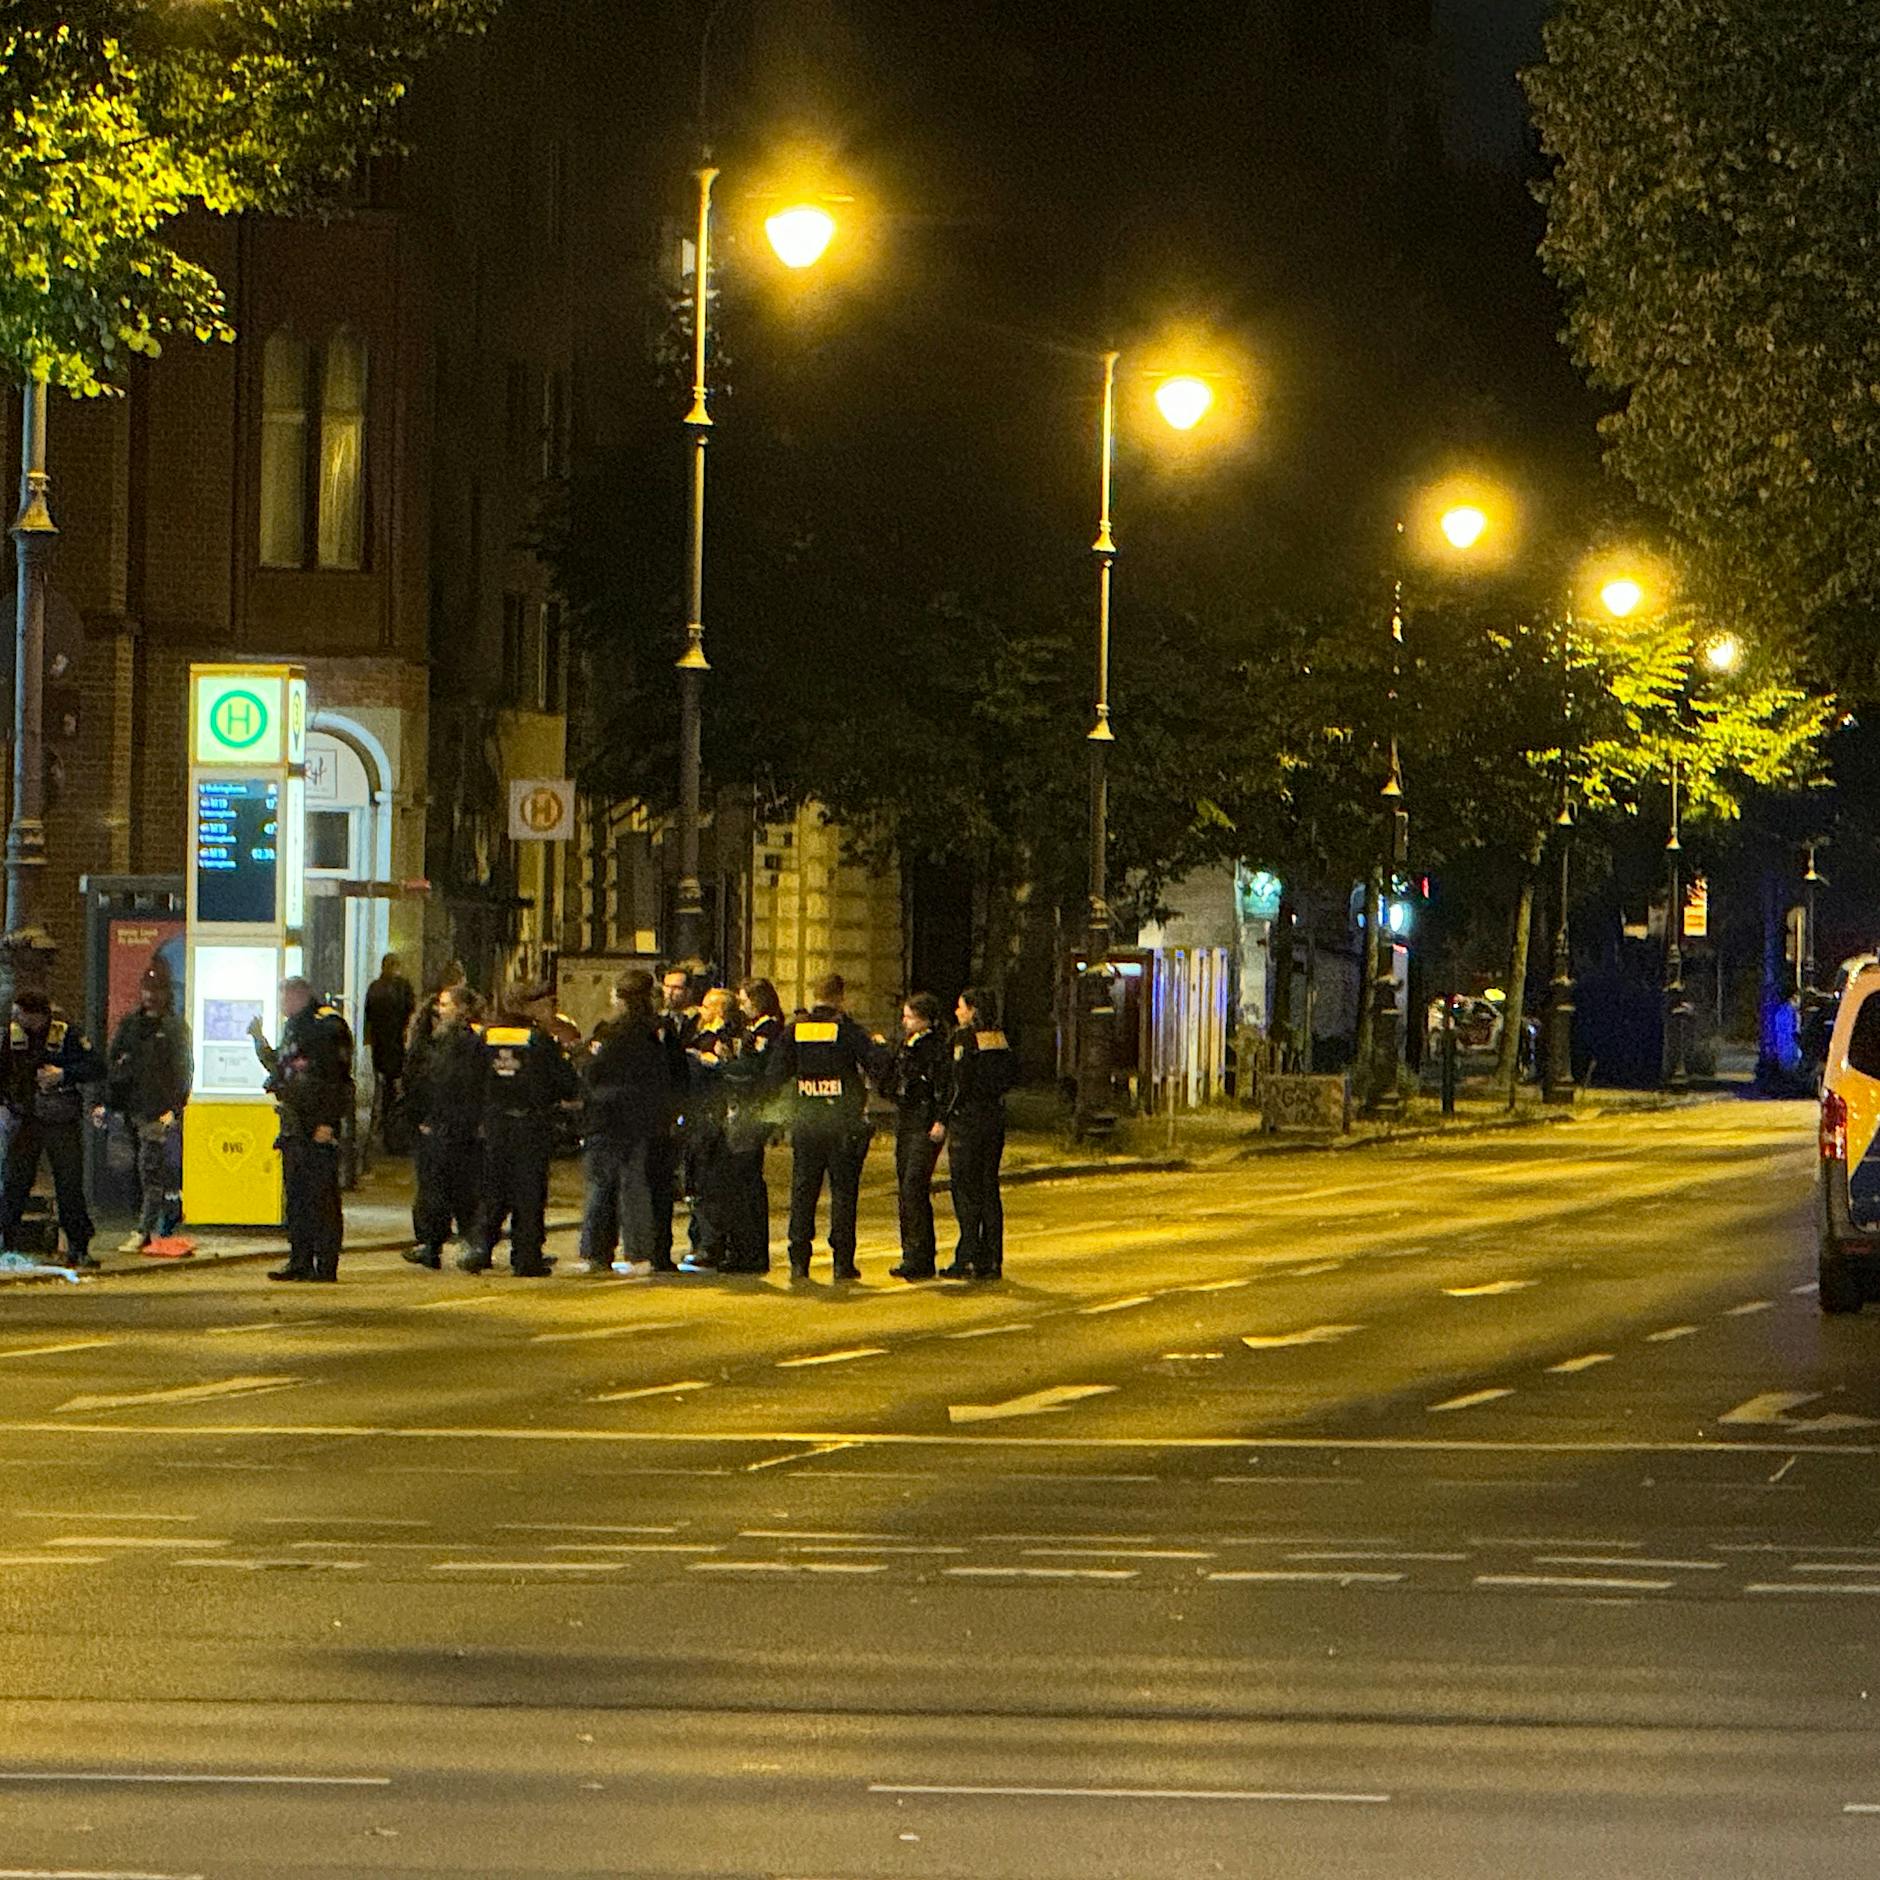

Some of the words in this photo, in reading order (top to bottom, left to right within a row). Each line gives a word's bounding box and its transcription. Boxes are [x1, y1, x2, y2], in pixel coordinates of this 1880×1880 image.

[228, 703, 250, 735] H
[530, 798, 552, 824] H
[797, 1080, 843, 1097] POLIZEI
